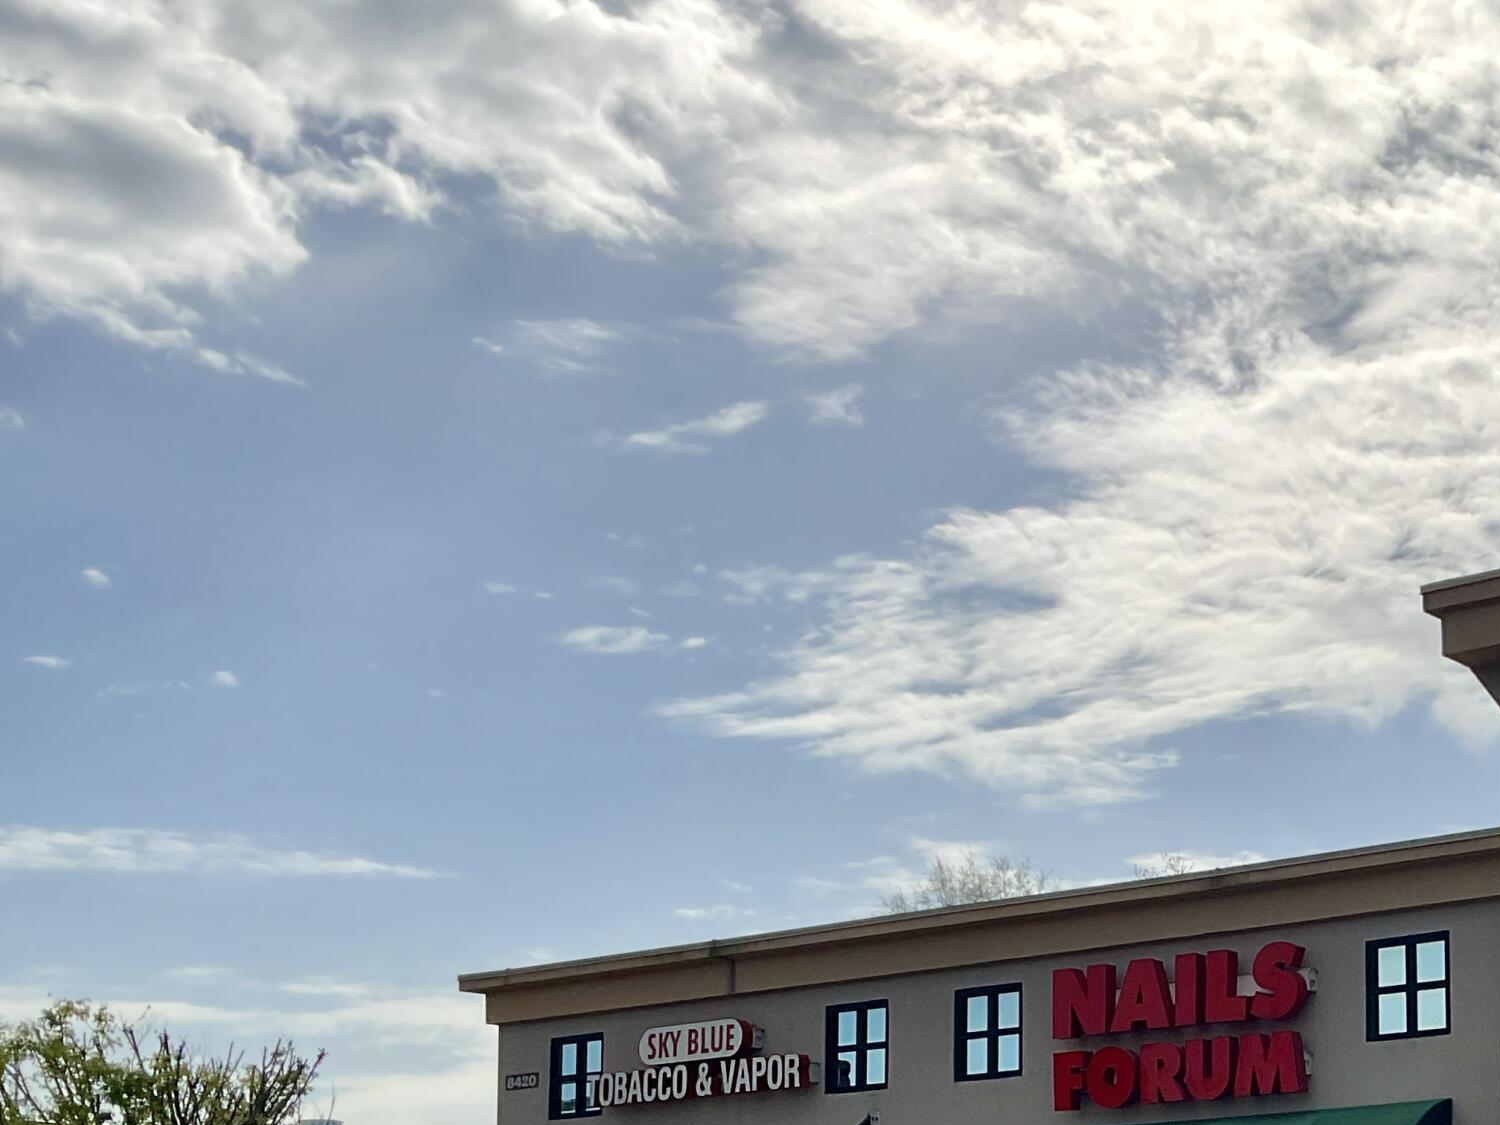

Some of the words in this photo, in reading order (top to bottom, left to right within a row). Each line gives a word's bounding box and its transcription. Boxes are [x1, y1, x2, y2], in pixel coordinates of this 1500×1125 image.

[1052, 941, 1306, 1039] NAILS
[647, 1029, 682, 1060] SKY
[687, 1024, 735, 1056] BLUE
[1053, 1030, 1308, 1112] FORUM
[586, 1064, 688, 1108] TOBACCO
[695, 1062, 712, 1097] &
[720, 1053, 800, 1095] VAPOR
